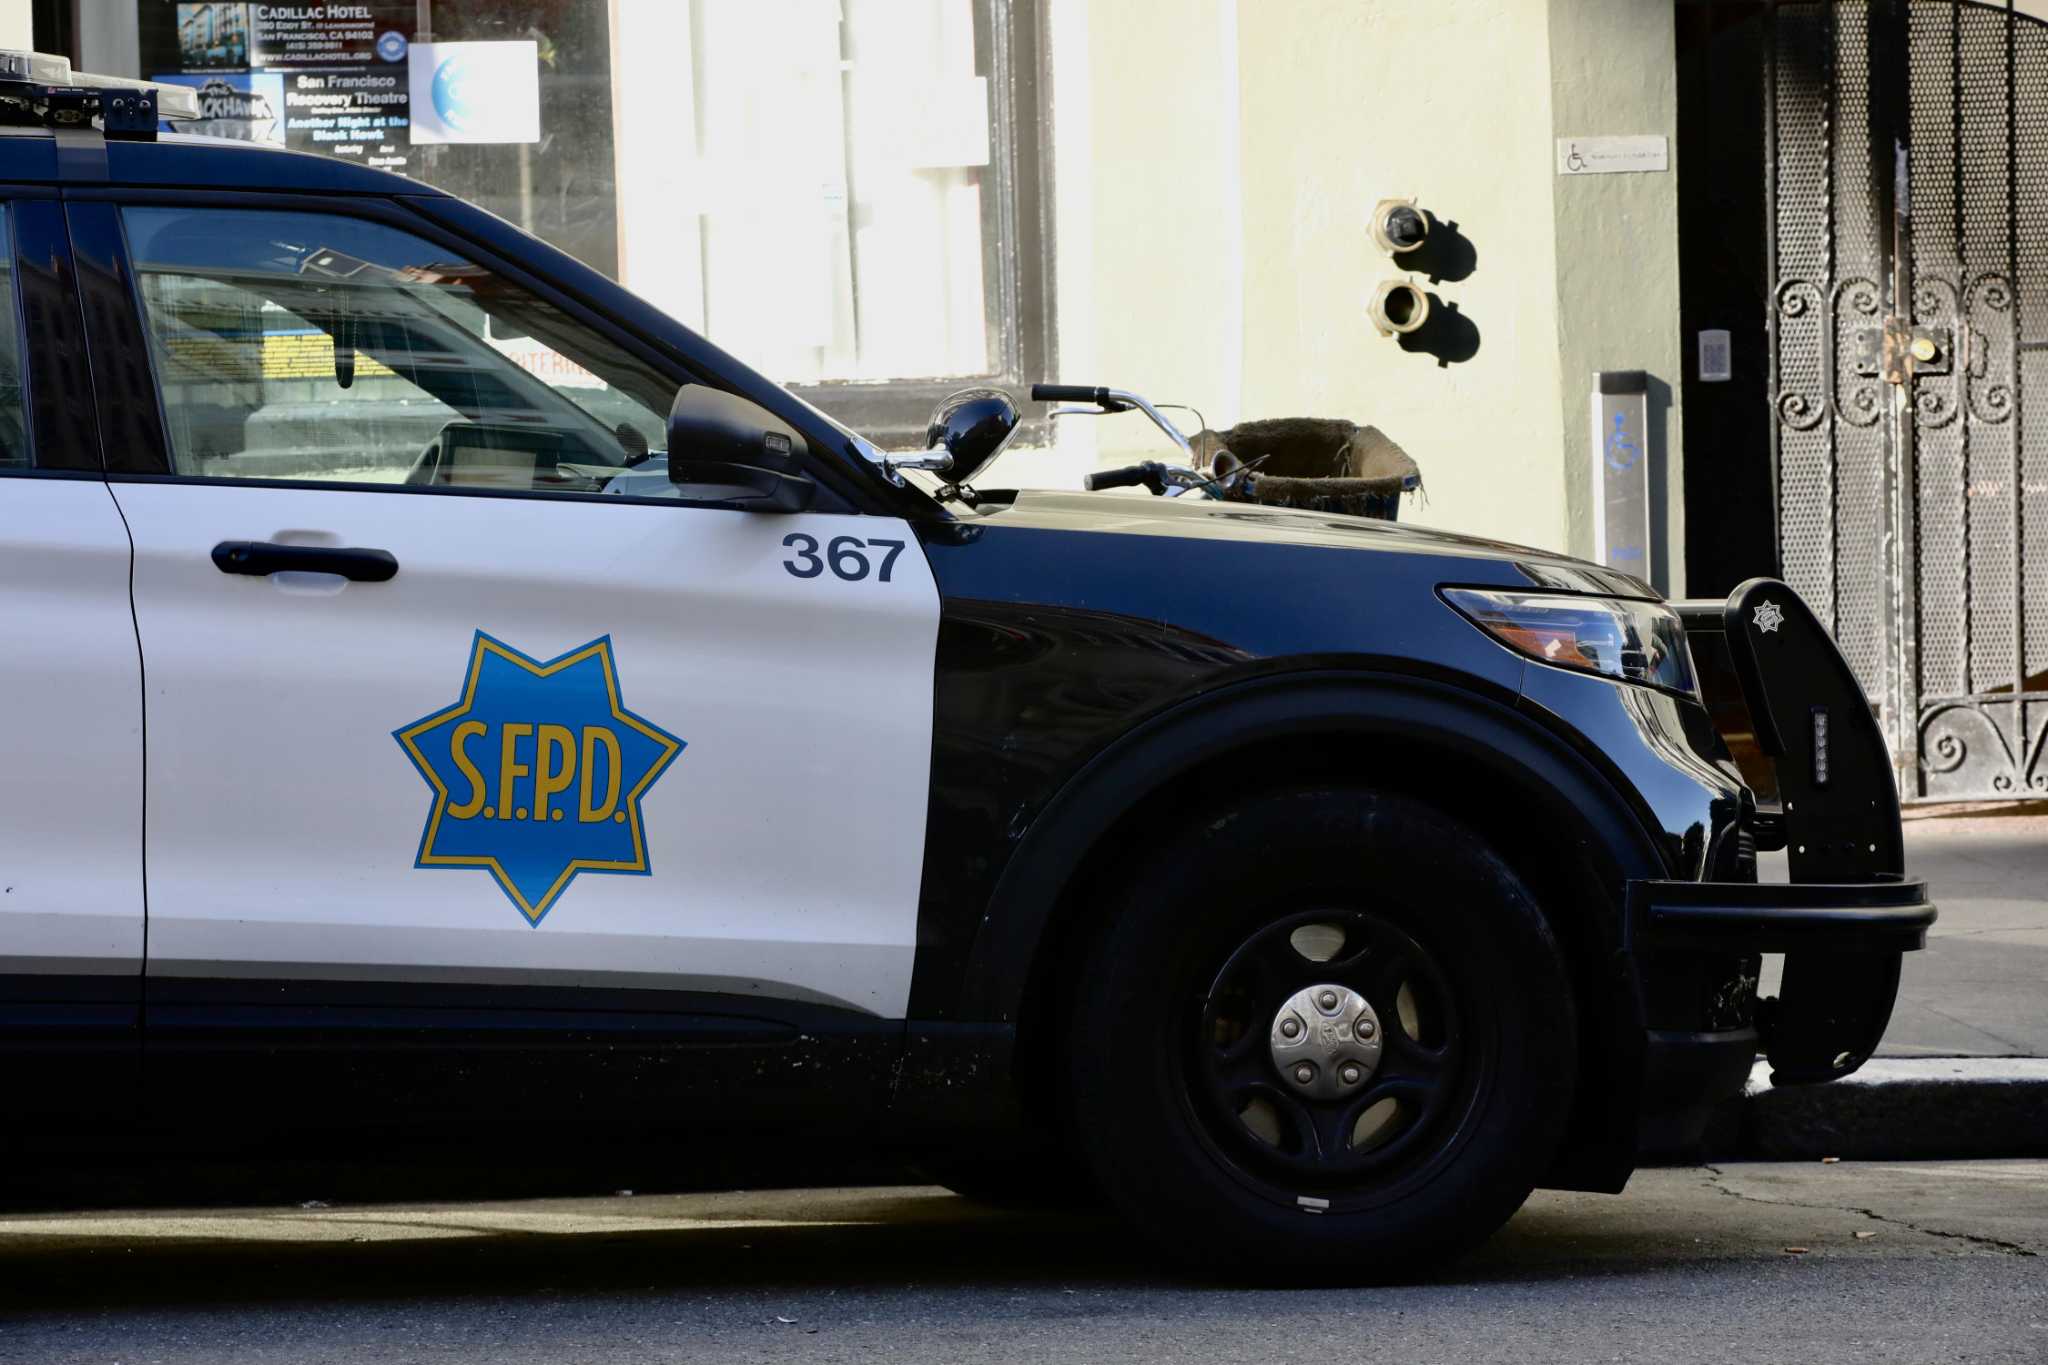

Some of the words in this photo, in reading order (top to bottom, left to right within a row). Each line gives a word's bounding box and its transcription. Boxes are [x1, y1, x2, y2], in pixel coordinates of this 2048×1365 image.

[257, 6, 324, 19] CADILLAC
[327, 5, 372, 19] HOTEL
[329, 31, 344, 40] CA
[297, 75, 325, 89] San
[327, 75, 396, 88] Francisco
[286, 91, 352, 108] Recovery
[354, 91, 408, 105] Theatre
[372, 117, 386, 128] at
[388, 116, 409, 127] the
[782, 533, 906, 583] 367
[447, 720, 626, 824] S.F.P.D.
